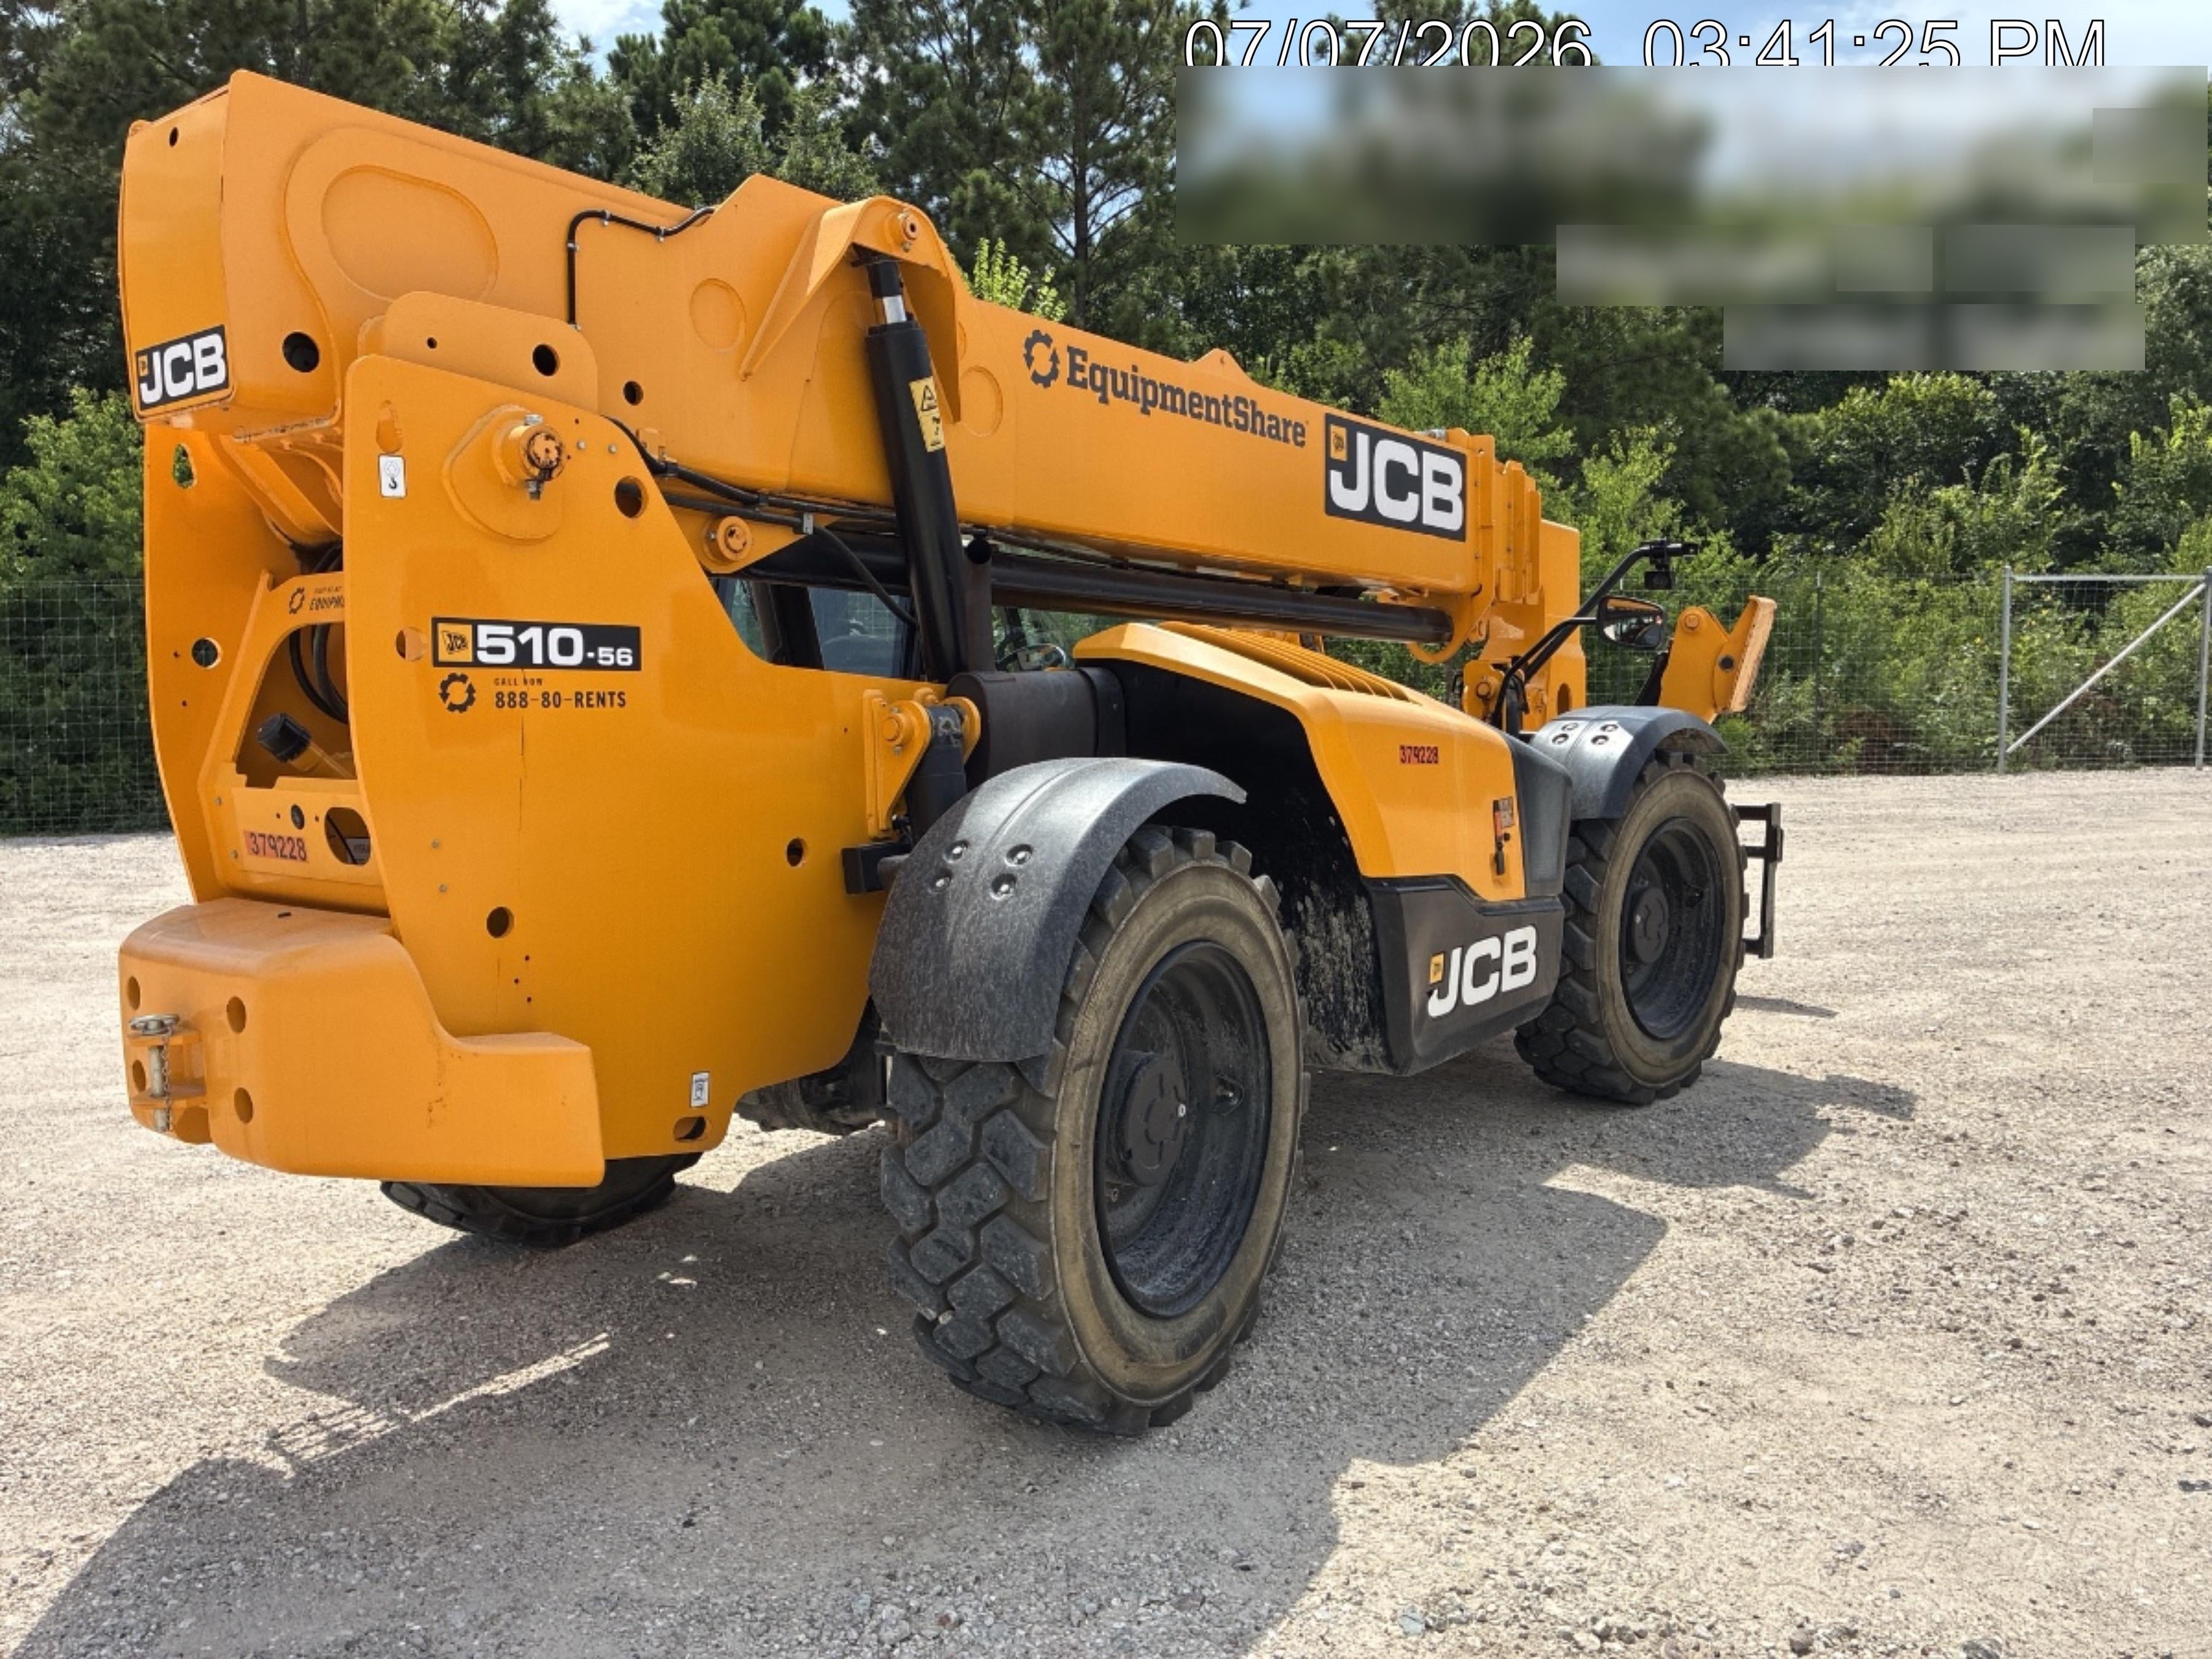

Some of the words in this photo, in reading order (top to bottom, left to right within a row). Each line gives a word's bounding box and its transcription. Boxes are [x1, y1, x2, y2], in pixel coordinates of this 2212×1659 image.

[141, 334, 226, 404] JCB
[1067, 345, 1306, 447] EquipmentShare
[1330, 431, 1464, 531] JCB
[477, 624, 633, 666] 510-56
[495, 691, 626, 708] 888-80-RENTS
[1400, 745, 1438, 764] 379228
[249, 832, 307, 861] 379228
[1428, 925, 1537, 1018] JCB
